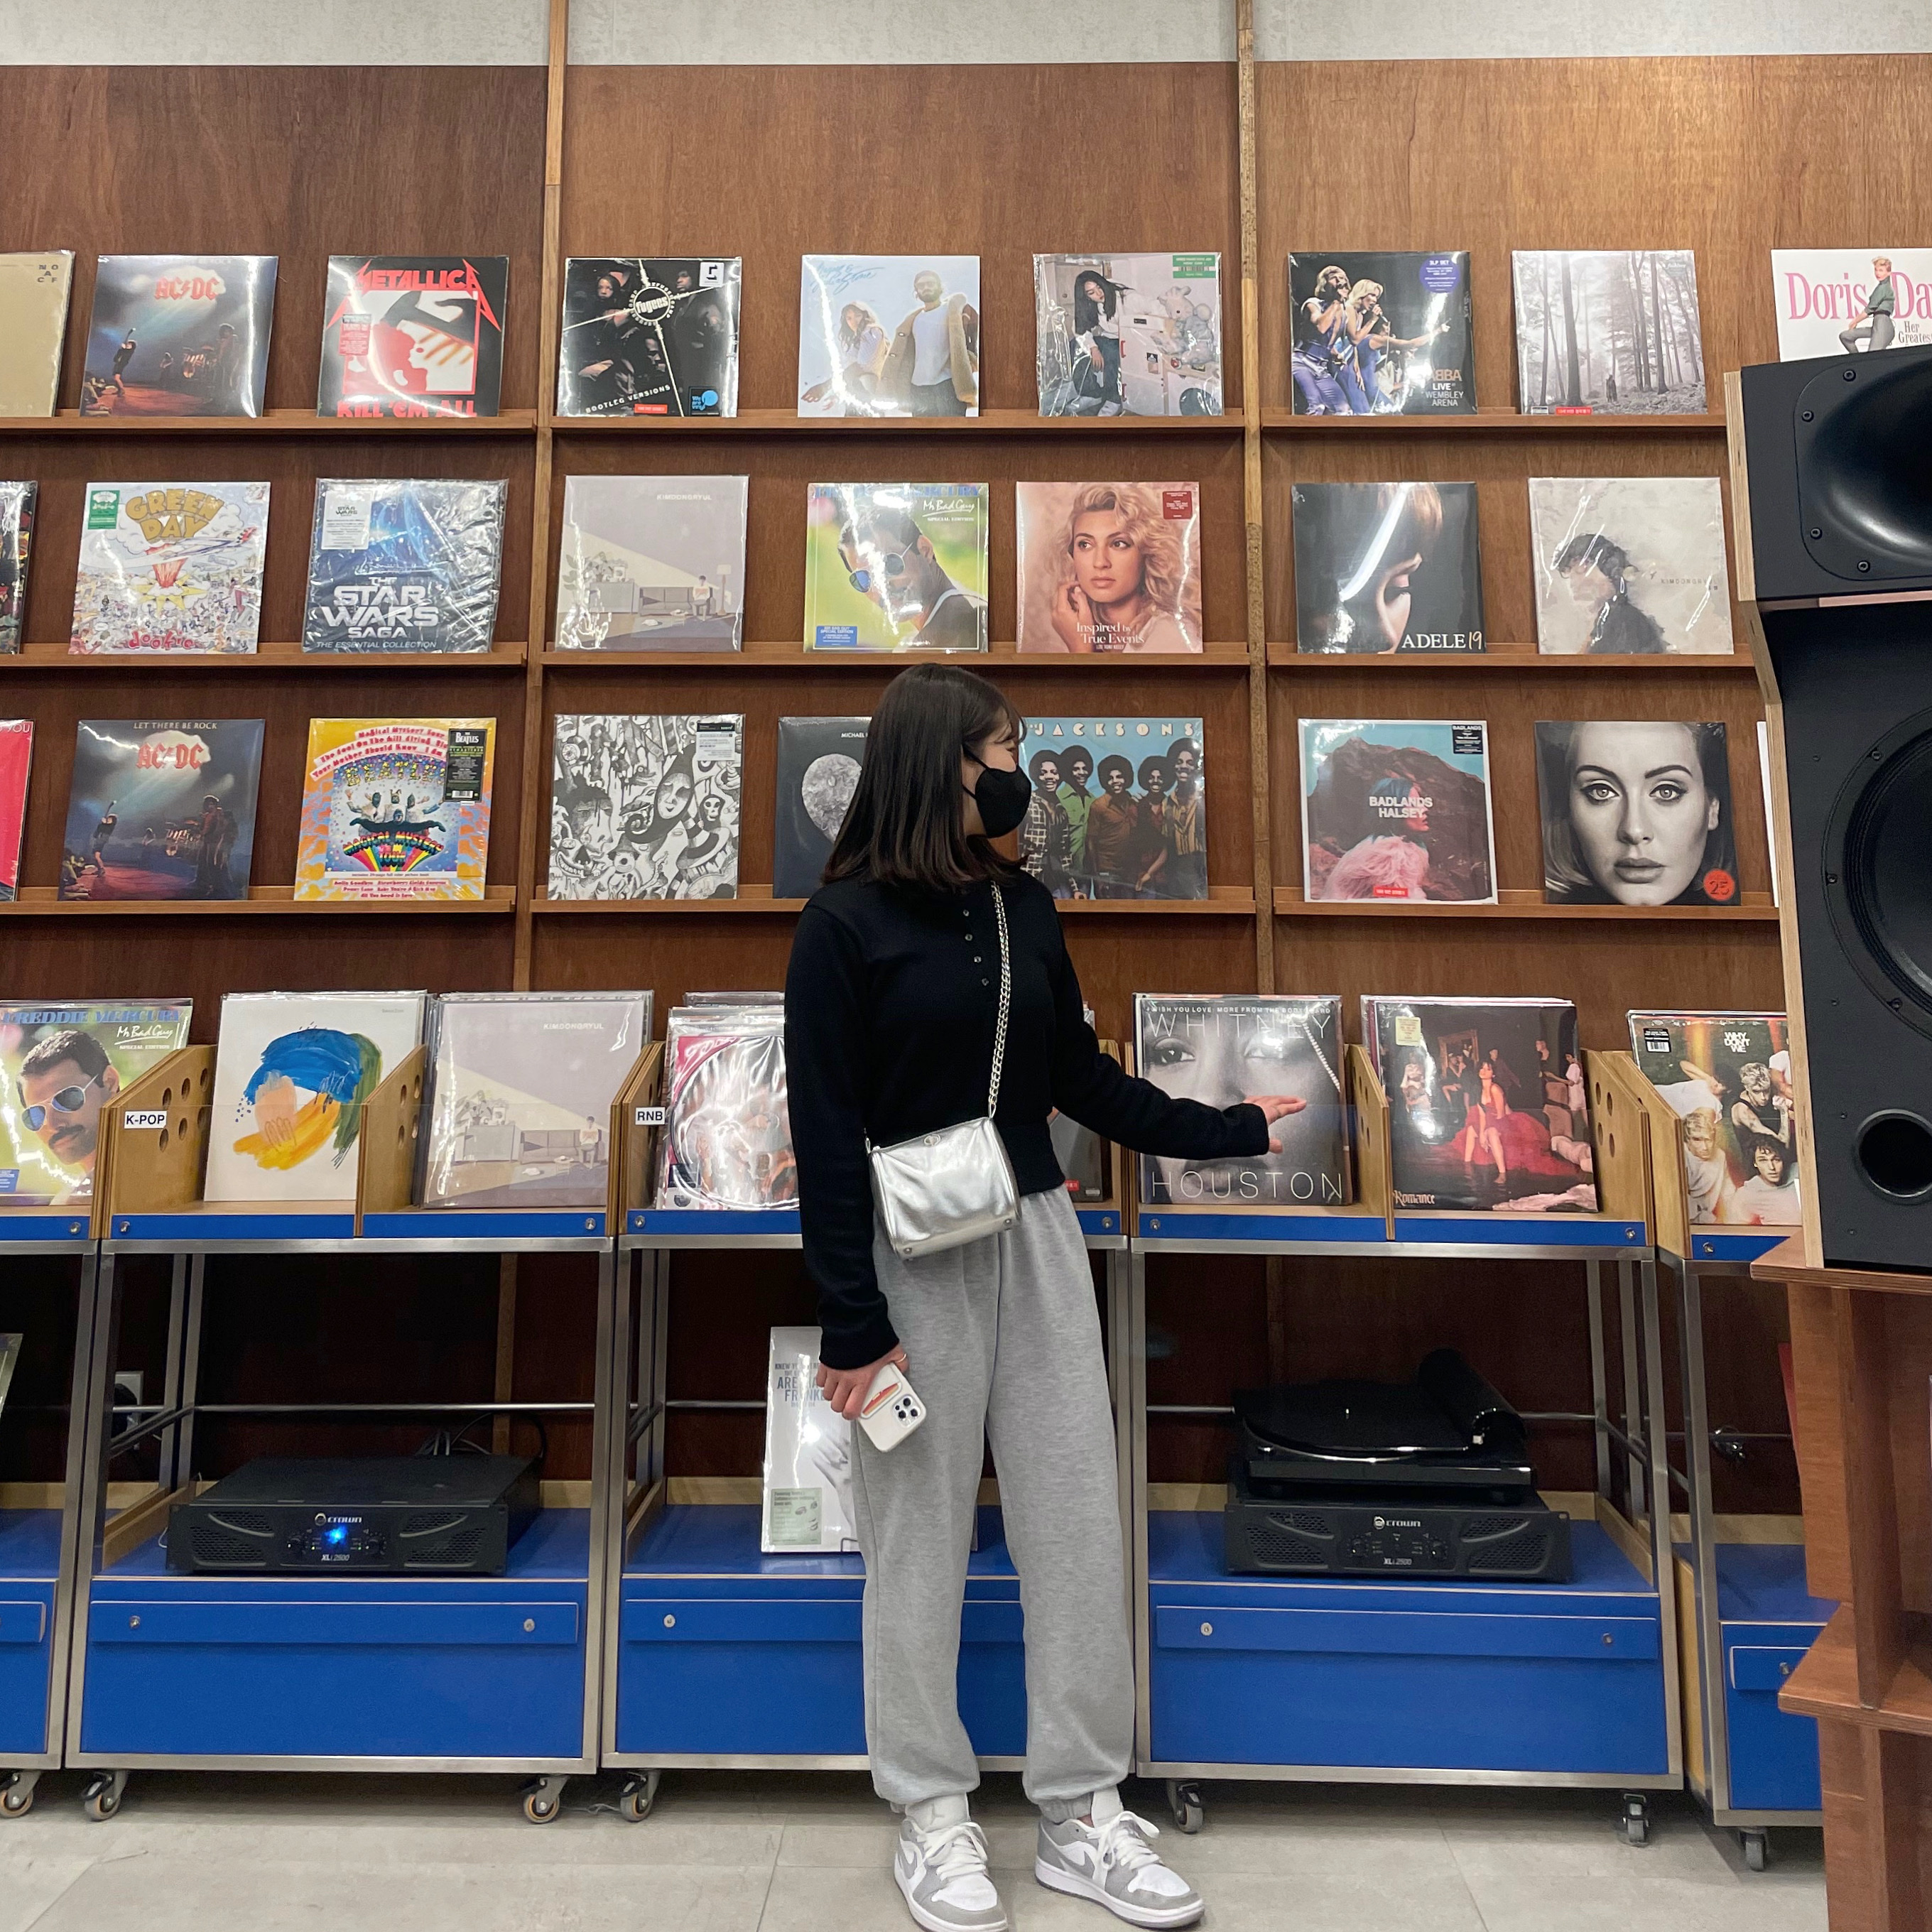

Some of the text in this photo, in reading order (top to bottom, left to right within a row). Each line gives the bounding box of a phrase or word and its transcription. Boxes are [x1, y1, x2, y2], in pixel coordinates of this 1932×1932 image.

[1784, 271, 1932, 320] Doris Da
[1904, 320, 1920, 333] Her
[1898, 331, 1932, 344] Greates
[586, 384, 671, 414] BOOTLEG VERSIONS
[1425, 391, 1464, 399] WEMBLEY
[1432, 398, 1458, 407] ARENA
[337, 401, 384, 418] KILL
[436, 401, 477, 418] ALL
[126, 489, 224, 520] GREEN
[141, 514, 211, 543] DAY
[369, 576, 398, 585] THE
[334, 585, 426, 606] STAR
[320, 606, 440, 626] WARS
[347, 626, 408, 639] SAGA
[1077, 622, 1121, 635] Inspired
[127, 631, 196, 649] dookie
[1080, 632, 1145, 644] True Events
[1401, 631, 1482, 651] ADELE 19
[1035, 722, 1195, 737] JACKSONS
[1369, 796, 1433, 808] BADLANDS
[1378, 807, 1425, 818] HALSEY
[1709, 880, 1730, 896] 25
[131, 1025, 151, 1037] Bad
[1148, 1014, 1331, 1039] WHITNEY
[126, 1114, 165, 1127] K-POP
[636, 1110, 663, 1122] RNB
[1151, 1171, 1342, 1200] HOUSTON
[1393, 1190, 1436, 1206] Romance
